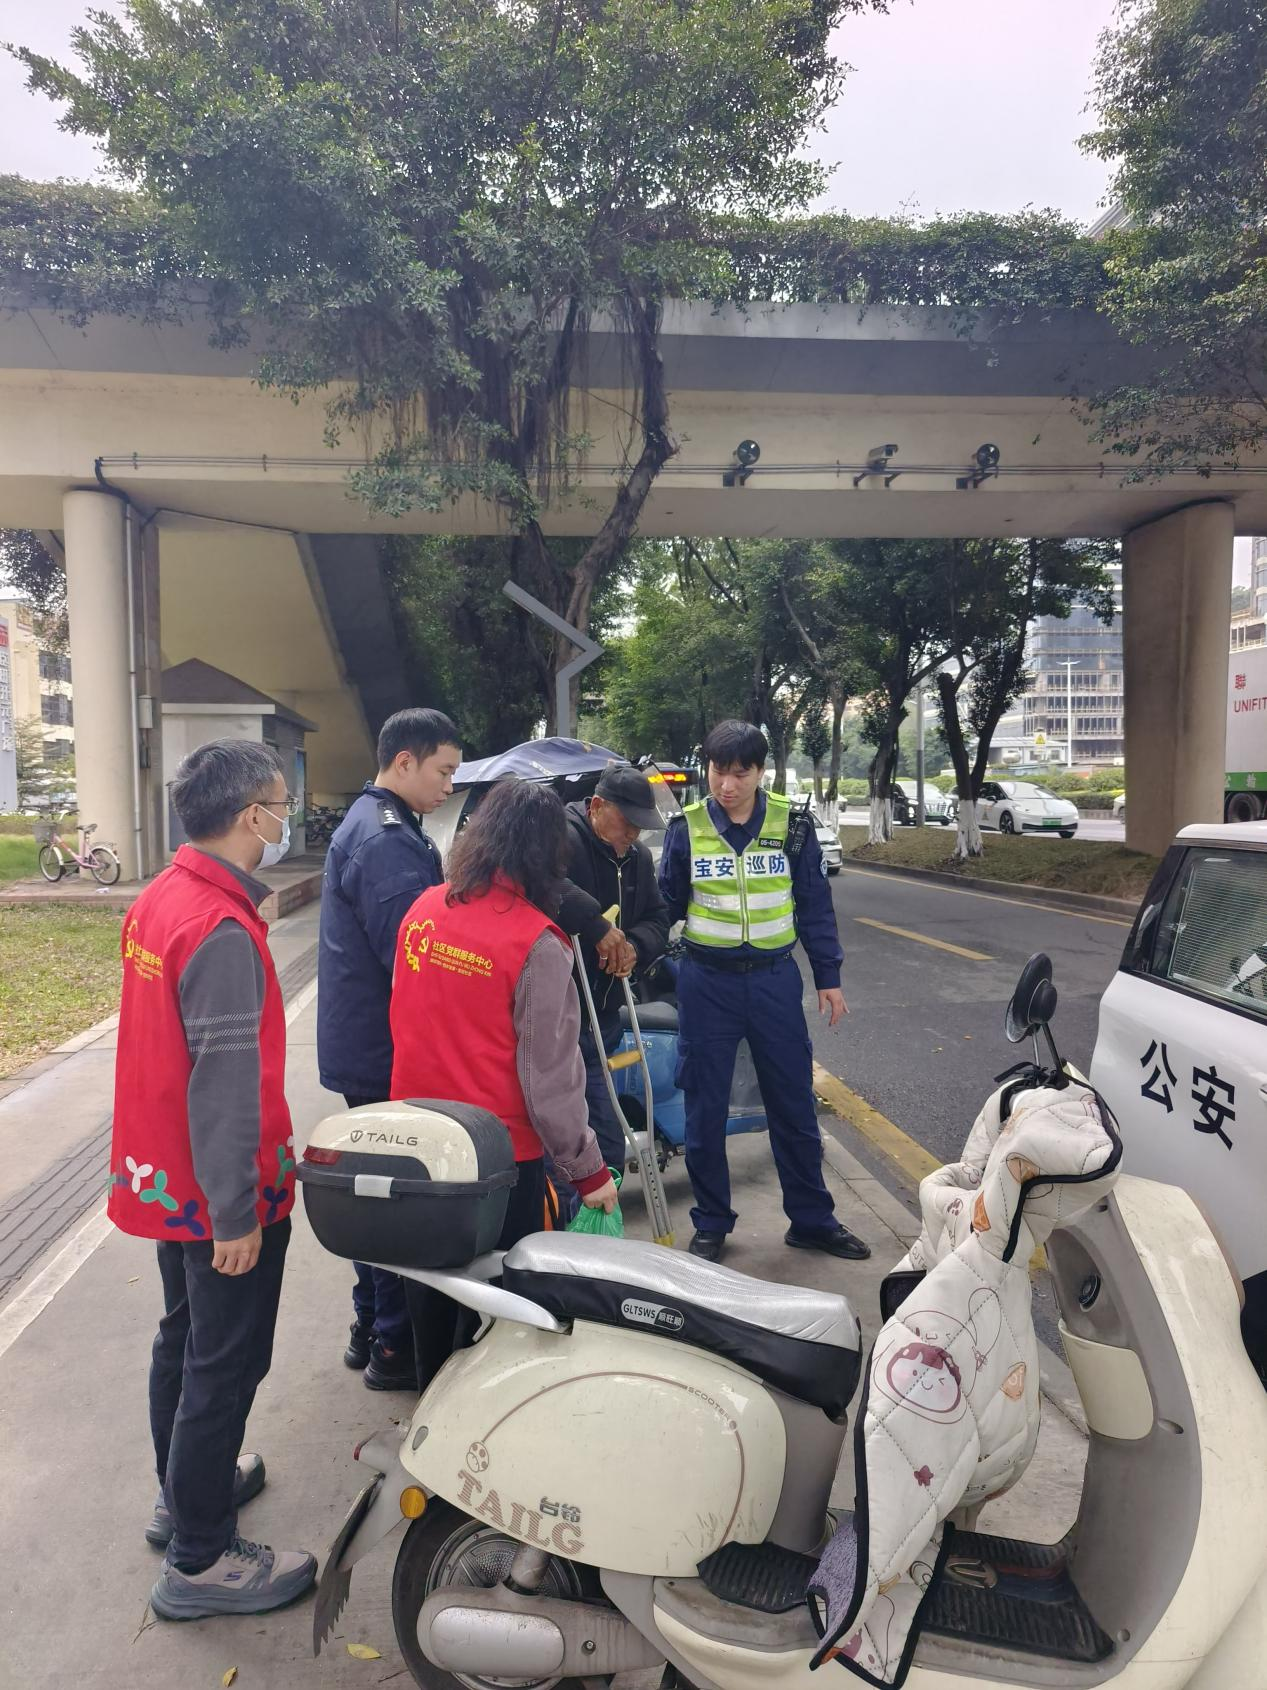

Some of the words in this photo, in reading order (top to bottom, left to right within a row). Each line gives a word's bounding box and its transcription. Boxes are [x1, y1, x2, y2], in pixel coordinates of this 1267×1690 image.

[694, 857, 735, 878] 宝安
[747, 853, 785, 875] 巡防
[1140, 1039, 1236, 1151] 公安
[367, 1132, 418, 1146] TAILG
[623, 1303, 656, 1319] GLTSWS
[688, 1386, 730, 1421] SCOOTER
[457, 1469, 585, 1556] TAILG
